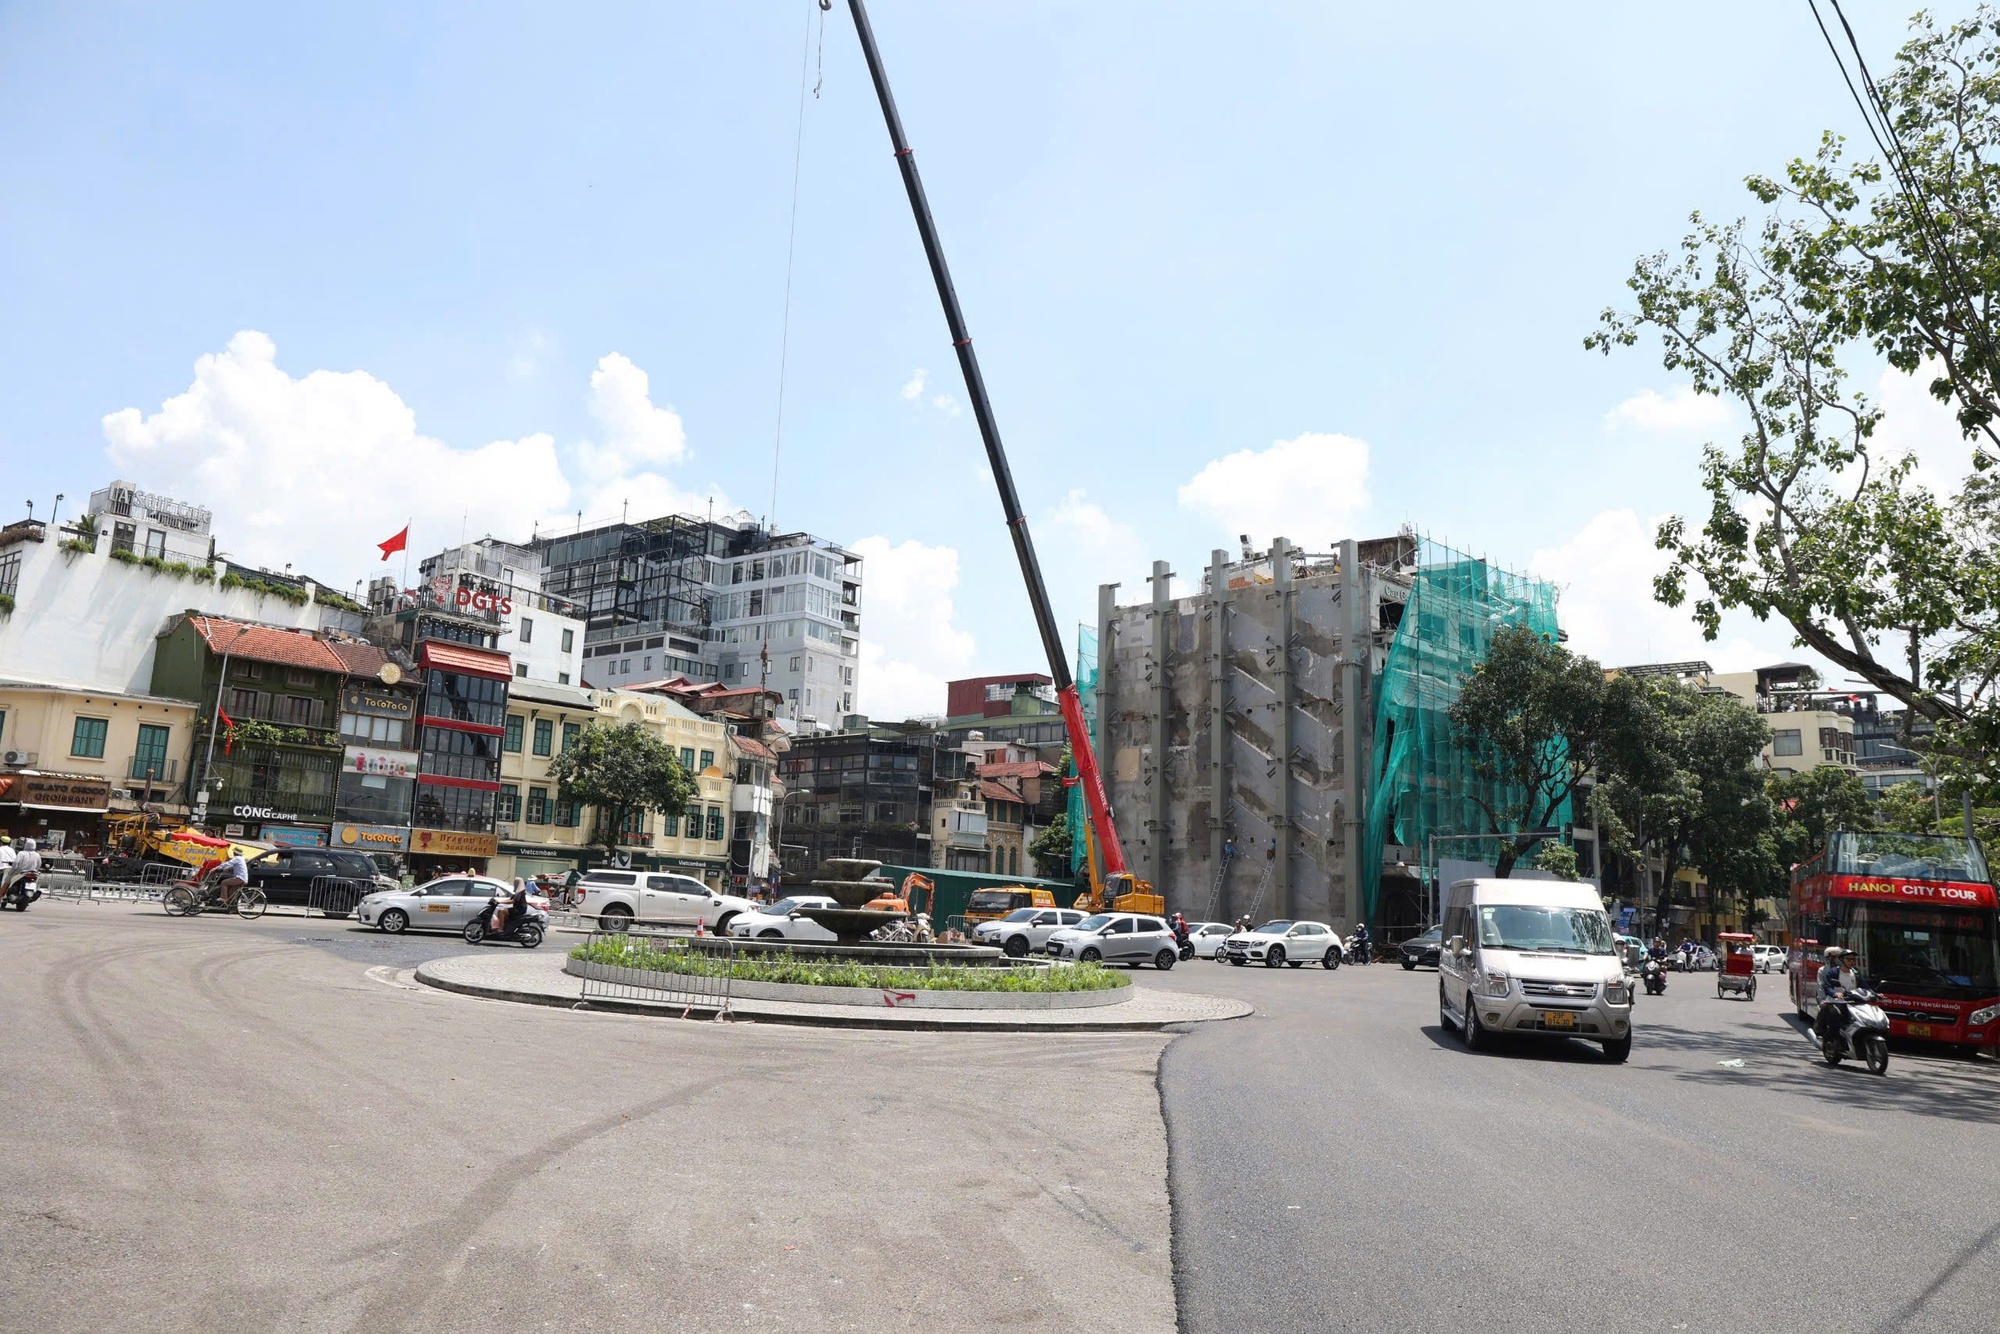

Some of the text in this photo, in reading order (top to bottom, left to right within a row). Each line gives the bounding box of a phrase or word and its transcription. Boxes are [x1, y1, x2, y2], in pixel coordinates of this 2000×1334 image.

[456, 588, 513, 615] DGTS
[71, 785, 106, 795] CHOCO
[35, 792, 96, 804] CROISSANT
[520, 848, 558, 857] Vietcombank
[678, 860, 707, 868] Vietcombank
[1848, 882, 1978, 900] HANOI CITY TOUR
